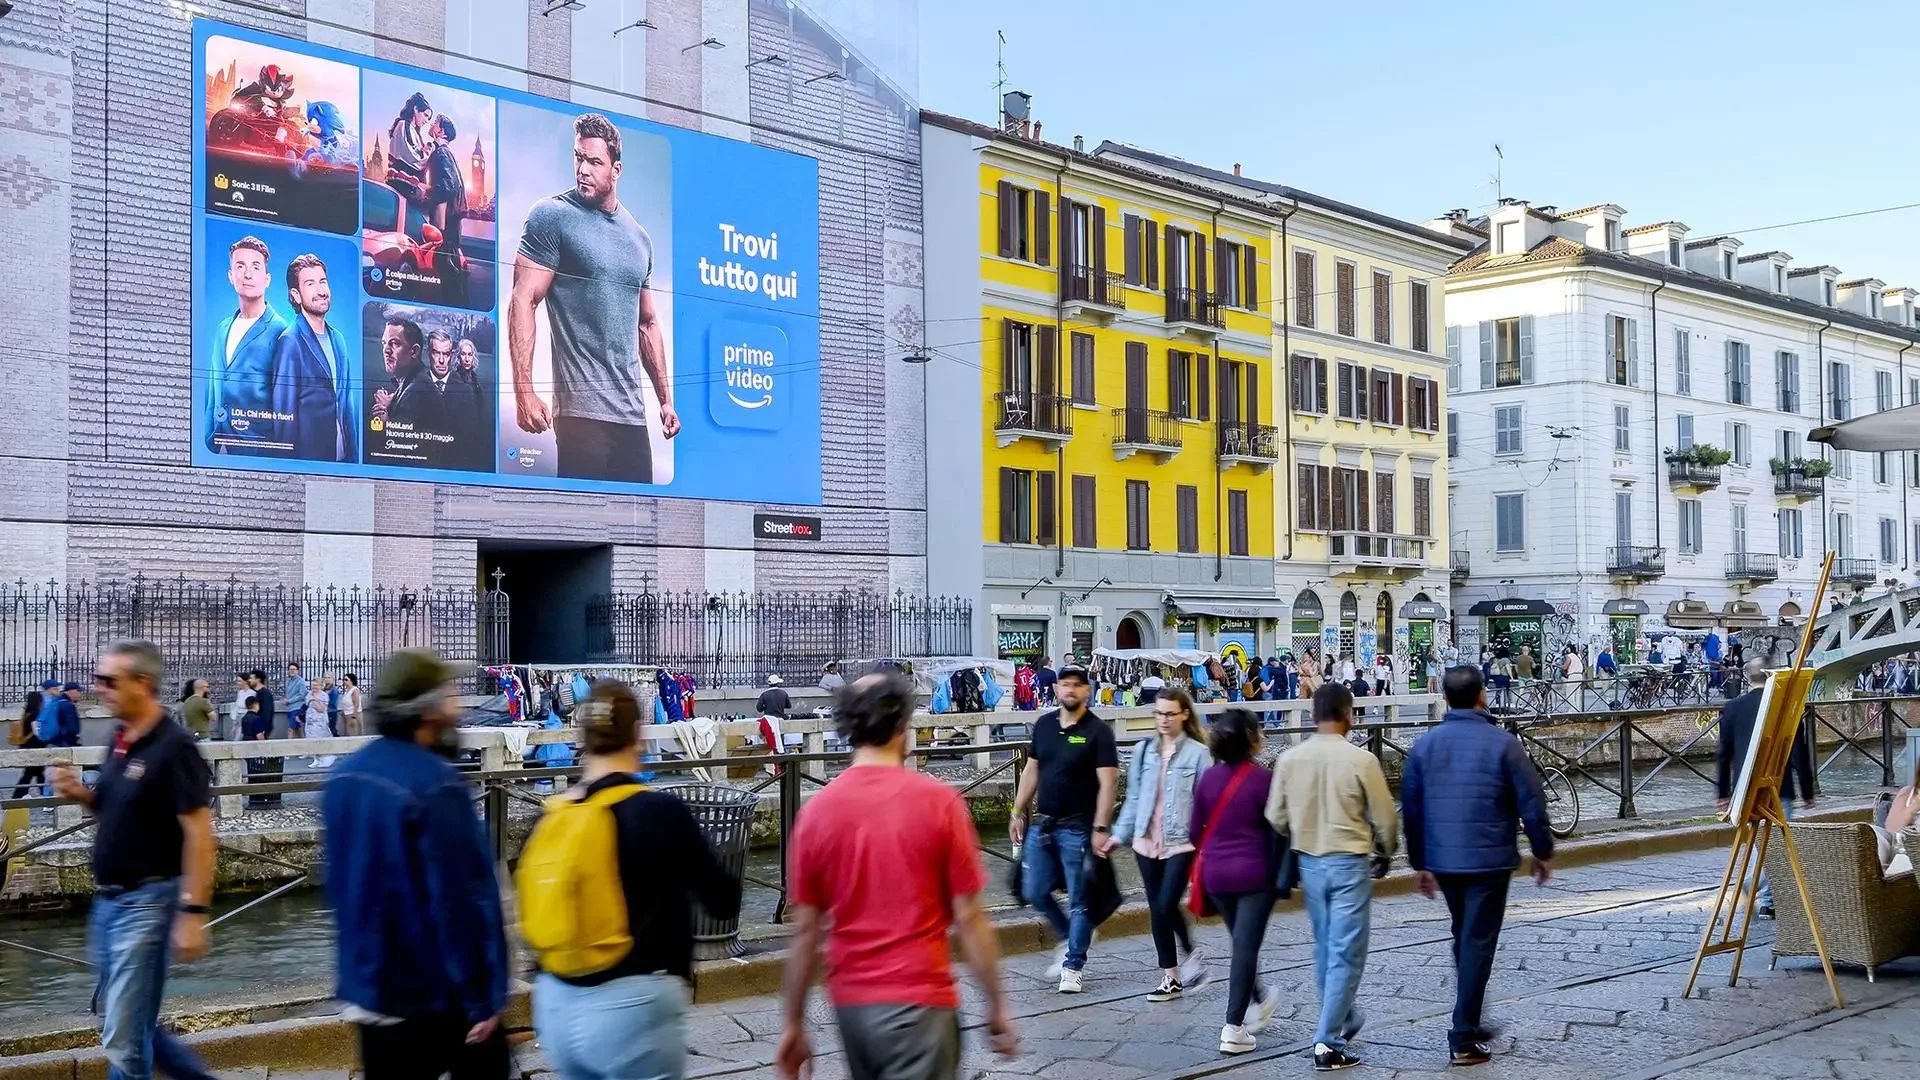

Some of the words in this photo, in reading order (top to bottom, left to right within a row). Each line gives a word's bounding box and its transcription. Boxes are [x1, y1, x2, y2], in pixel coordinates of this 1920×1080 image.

[231, 179, 250, 190] Sonic
[251, 183, 256, 191] 3
[261, 184, 276, 194] Film
[719, 223, 777, 260] Trovi
[385, 268, 391, 277] È
[390, 271, 407, 280] colpa
[407, 273, 420, 281] mia:
[420, 274, 441, 284] Londra
[385, 279, 402, 287] prime
[698, 256, 758, 292] tutto
[762, 270, 797, 301] qui
[724, 342, 774, 367] prime
[726, 366, 774, 391] video
[231, 408, 246, 417] LOL:
[247, 410, 258, 418] Chi
[259, 411, 272, 420] ride
[277, 412, 294, 421] fuori
[231, 419, 250, 427] prime
[385, 421, 414, 431] MobLand
[385, 430, 405, 438] Nuova
[405, 431, 420, 439] serie
[432, 434, 455, 443] maggio
[520, 447, 543, 455] Reacher
